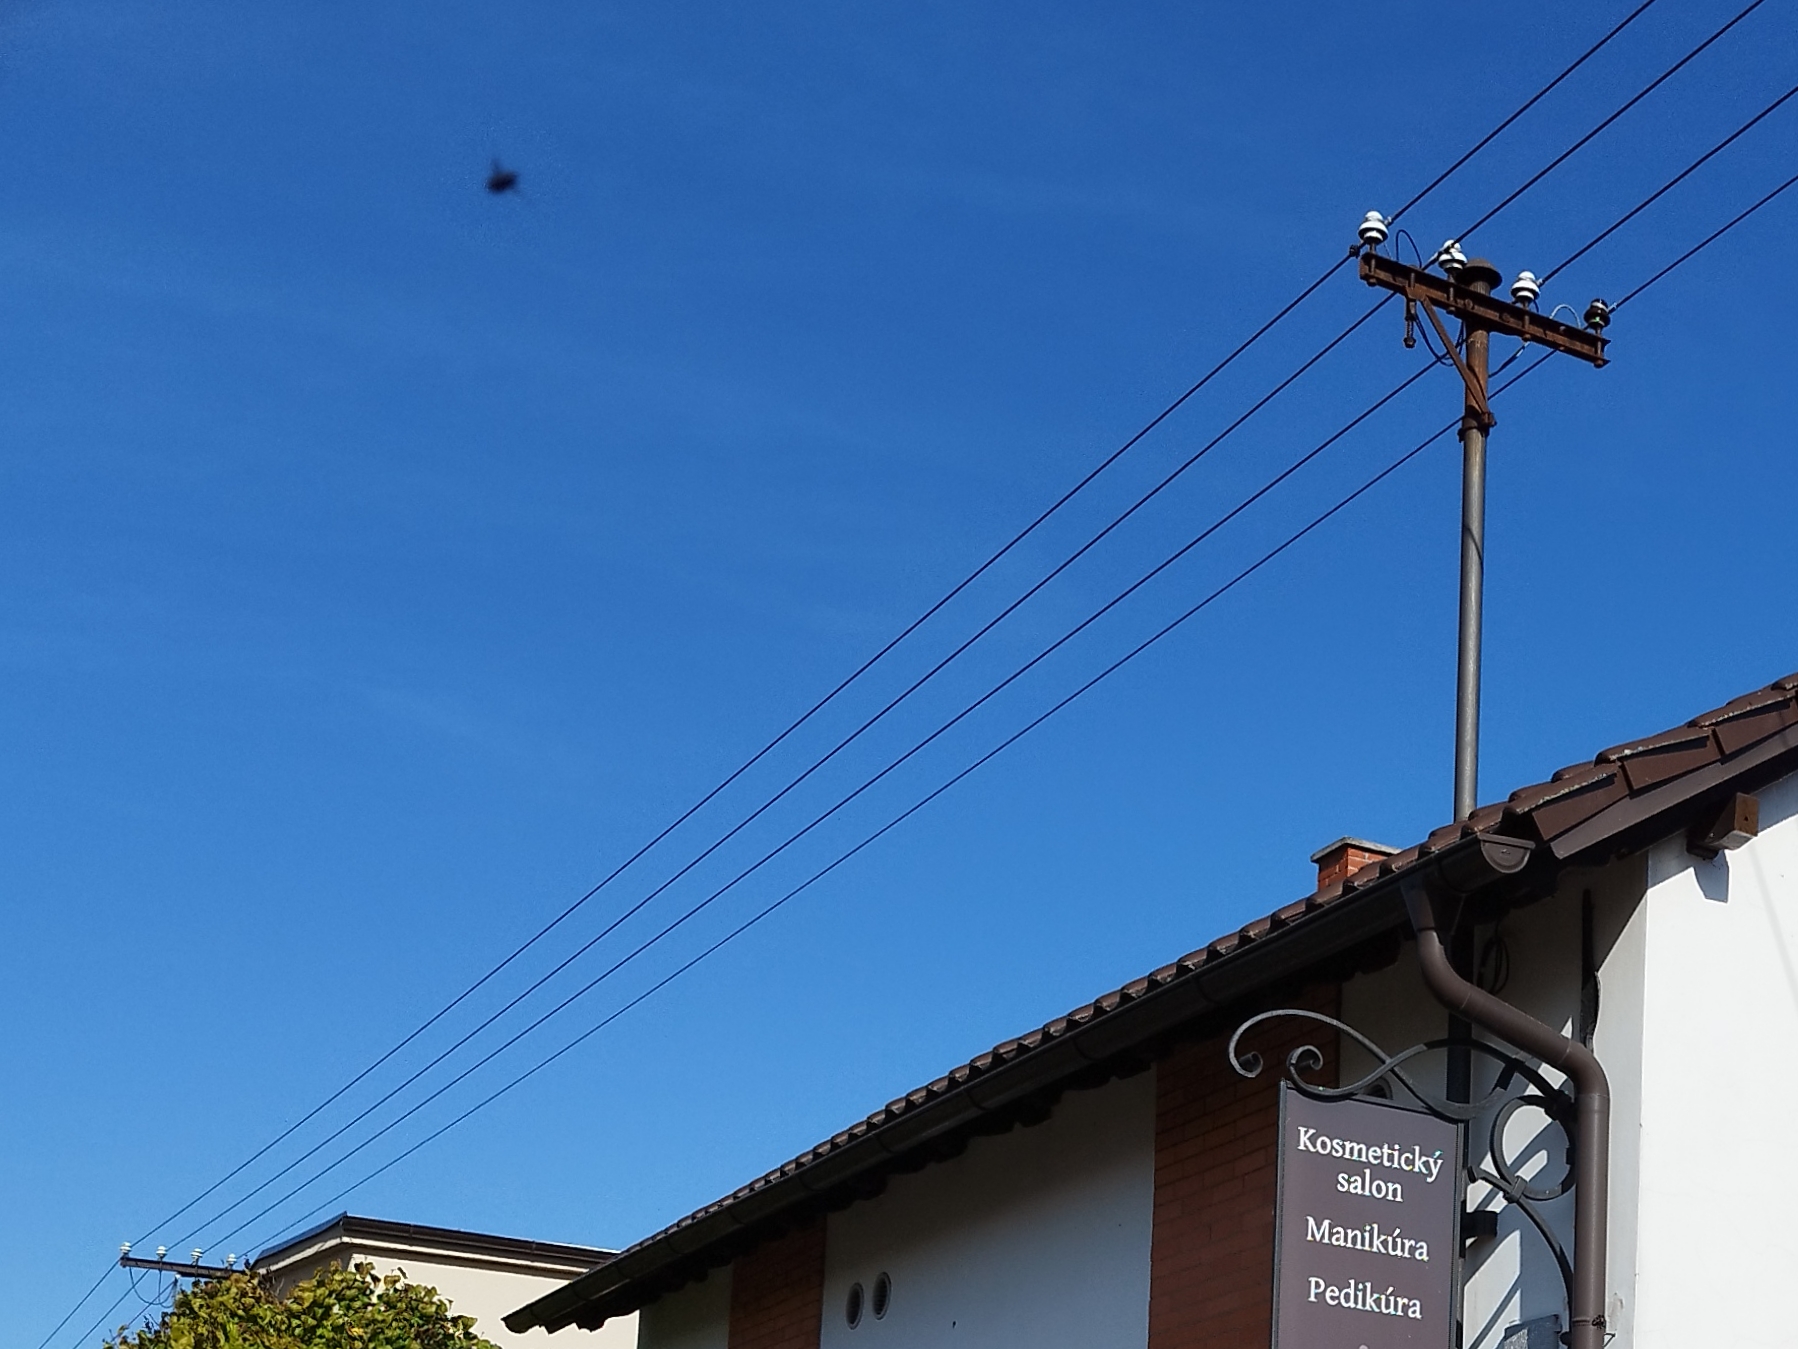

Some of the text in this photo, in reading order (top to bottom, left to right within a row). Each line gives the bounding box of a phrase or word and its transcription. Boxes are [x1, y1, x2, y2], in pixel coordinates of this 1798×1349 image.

[1297, 1126, 1444, 1183] Kosmetický
[1337, 1168, 1404, 1202] salon
[1305, 1215, 1429, 1262] Manikúra
[1308, 1276, 1423, 1320] Pedikúra
